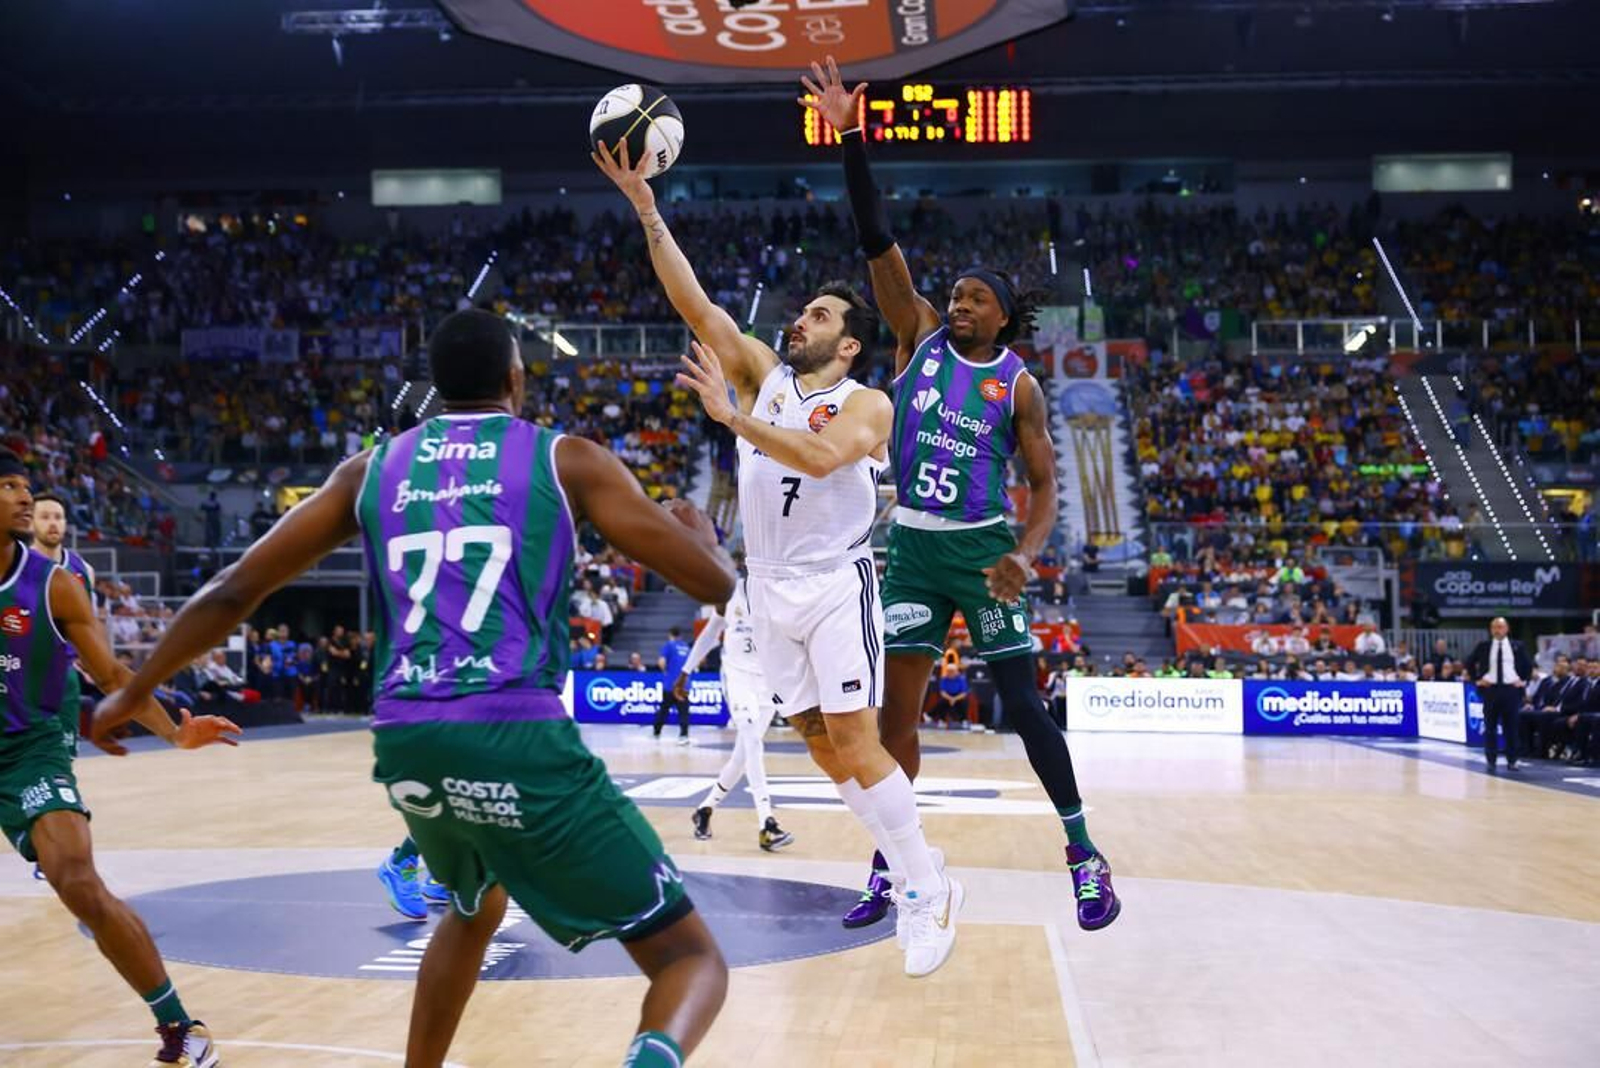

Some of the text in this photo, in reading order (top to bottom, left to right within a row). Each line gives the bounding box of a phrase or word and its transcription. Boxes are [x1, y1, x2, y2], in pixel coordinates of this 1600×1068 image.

[937, 402, 992, 437] unicaja
[417, 437, 497, 463] Sima
[915, 462, 960, 504] 55
[781, 476, 801, 517] 7
[388, 525, 512, 634] 77
[1434, 578, 1485, 595] Copa
[1511, 579, 1544, 597] Rey
[591, 680, 722, 704] mediolum
[1089, 690, 1224, 709] mediolanum
[1262, 690, 1403, 714] mediolanum
[442, 777, 521, 800] COSTA
[482, 801, 523, 816] SOL
